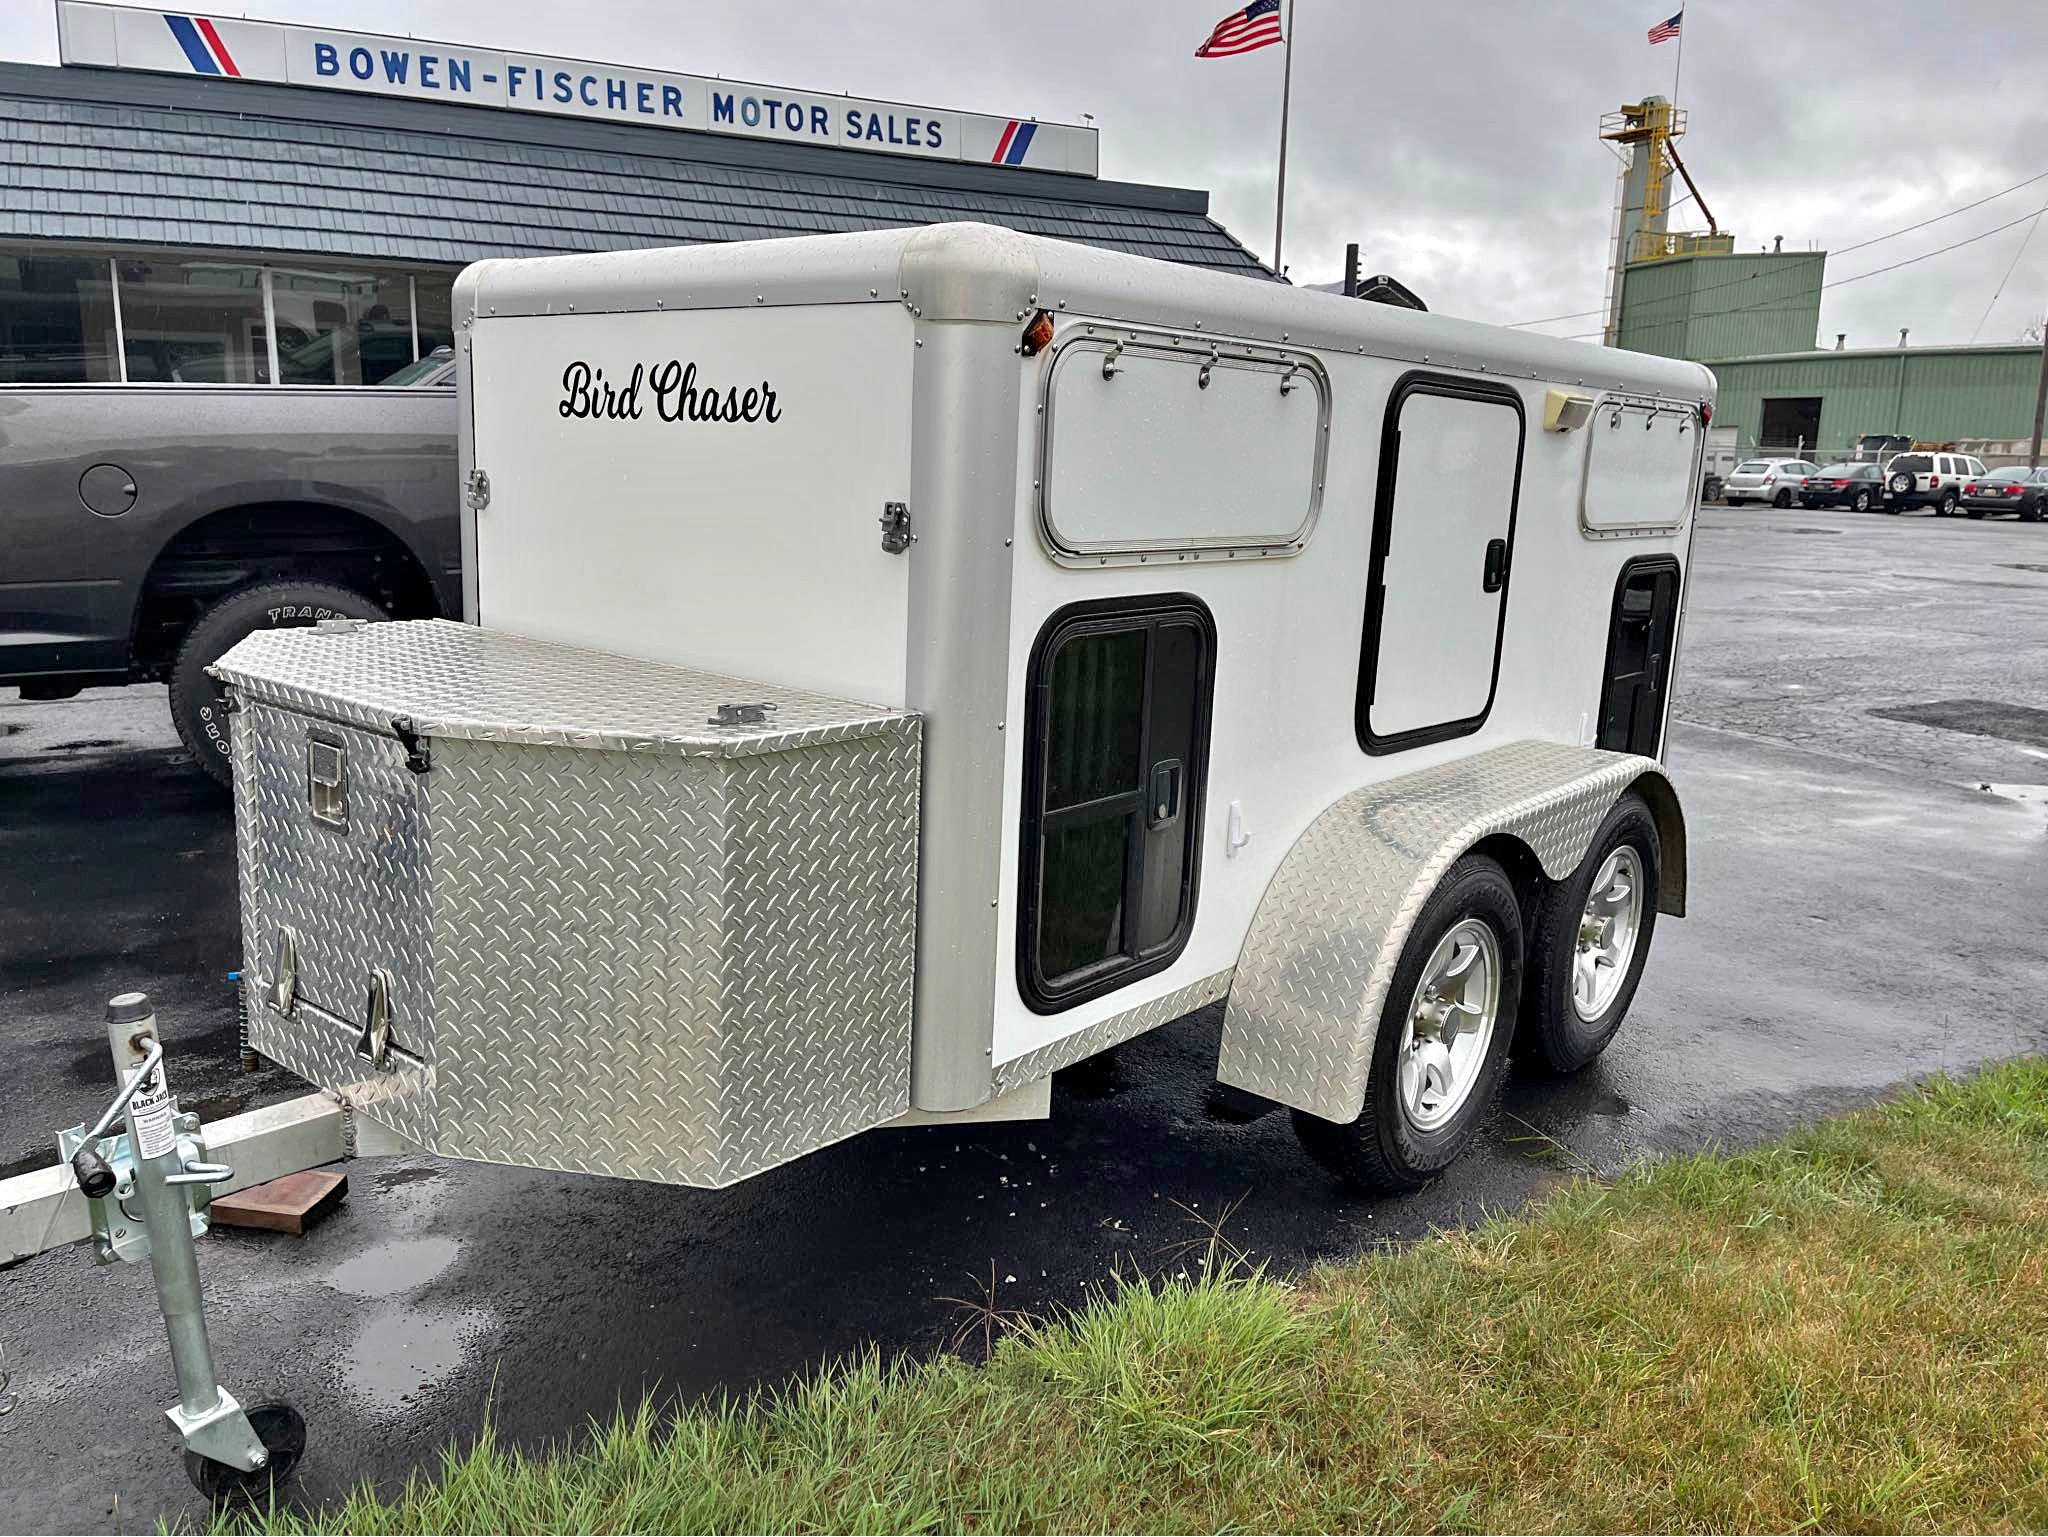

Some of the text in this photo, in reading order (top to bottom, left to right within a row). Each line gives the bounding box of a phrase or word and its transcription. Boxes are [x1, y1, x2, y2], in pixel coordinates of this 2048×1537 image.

[314, 43, 942, 148] BOWEN-FISCHER MOTOR SALES
[559, 360, 782, 423] Bird Chaser
[132, 1097, 155, 1110] BLACK
